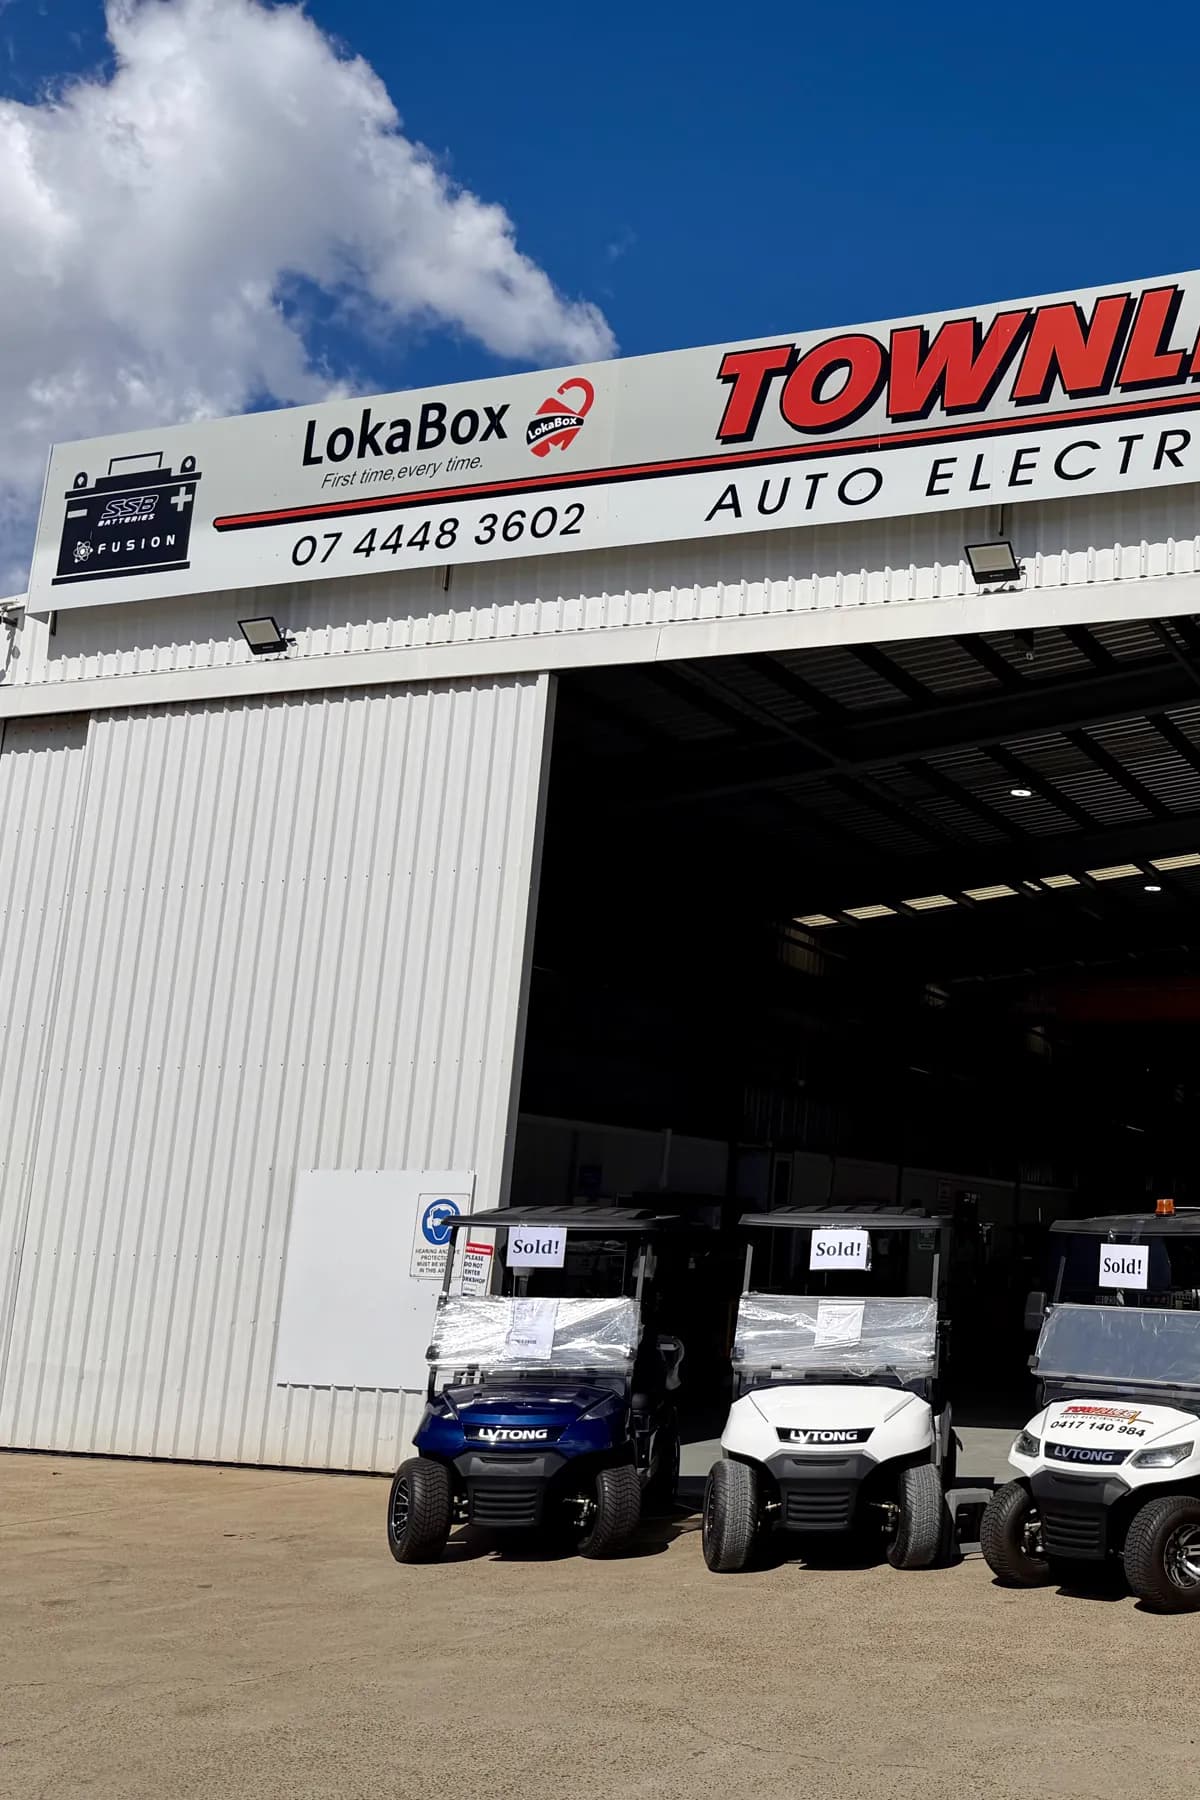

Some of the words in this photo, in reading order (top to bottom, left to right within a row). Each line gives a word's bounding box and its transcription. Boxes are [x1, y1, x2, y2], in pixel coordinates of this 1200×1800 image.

[302, 402, 510, 466] LokaBox
[527, 417, 577, 440] LokaBox
[321, 472, 357, 489] First
[445, 455, 484, 472] time.
[705, 466, 883, 522] AUTO
[101, 495, 159, 519] SSB
[98, 513, 155, 527] BATTERIES
[291, 531, 342, 566] 07
[352, 517, 459, 558] 4448
[474, 503, 585, 545] 3602
[98, 534, 176, 554] FUSION
[513, 1239, 559, 1255] Sold!
[816, 1241, 861, 1257] Sold!
[1103, 1257, 1142, 1275] Sold!
[479, 1429, 548, 1441] LVTONG
[790, 1430, 858, 1442] LVTONG
[1050, 1421, 1085, 1429] 0417
[1089, 1421, 1114, 1432] 140
[1117, 1426, 1146, 1437] 984
[1054, 1445, 1114, 1461] LVTONG
